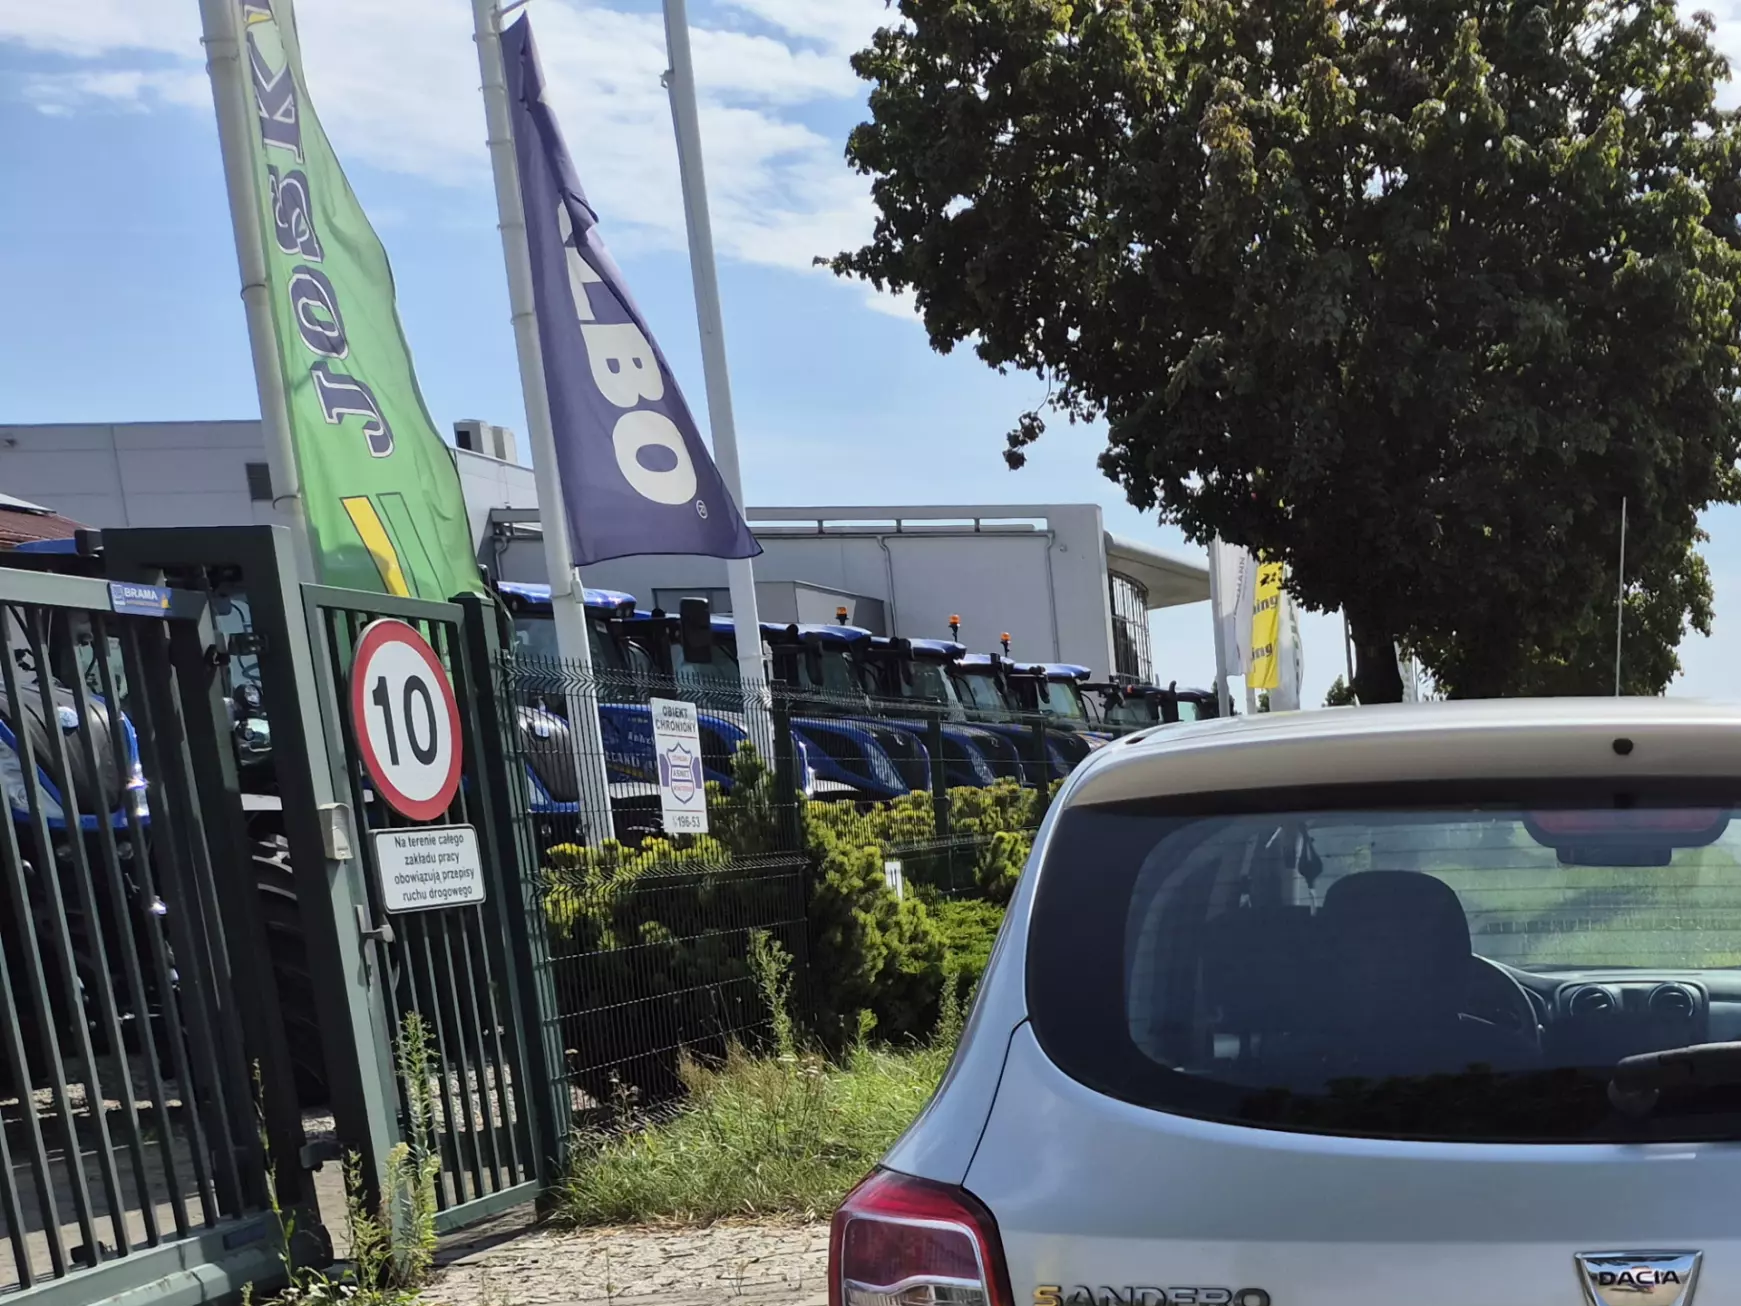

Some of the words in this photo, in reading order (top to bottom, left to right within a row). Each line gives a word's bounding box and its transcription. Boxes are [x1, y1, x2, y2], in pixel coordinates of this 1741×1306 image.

[124, 587, 158, 600] BRAMA
[372, 675, 438, 765] 10
[662, 706, 688, 718] OBIEKT
[655, 719, 696, 732] CHRONIONY
[394, 836, 406, 848] Na
[408, 834, 436, 847] terenie
[438, 832, 464, 846] całego
[404, 852, 436, 865] zakładu
[438, 851, 460, 867] pracy
[394, 869, 441, 885] obowiązują
[442, 867, 474, 883] przepisy
[403, 889, 427, 901] ruchu
[429, 885, 473, 900] drogowego
[1598, 1270, 1682, 1286] DACIA
